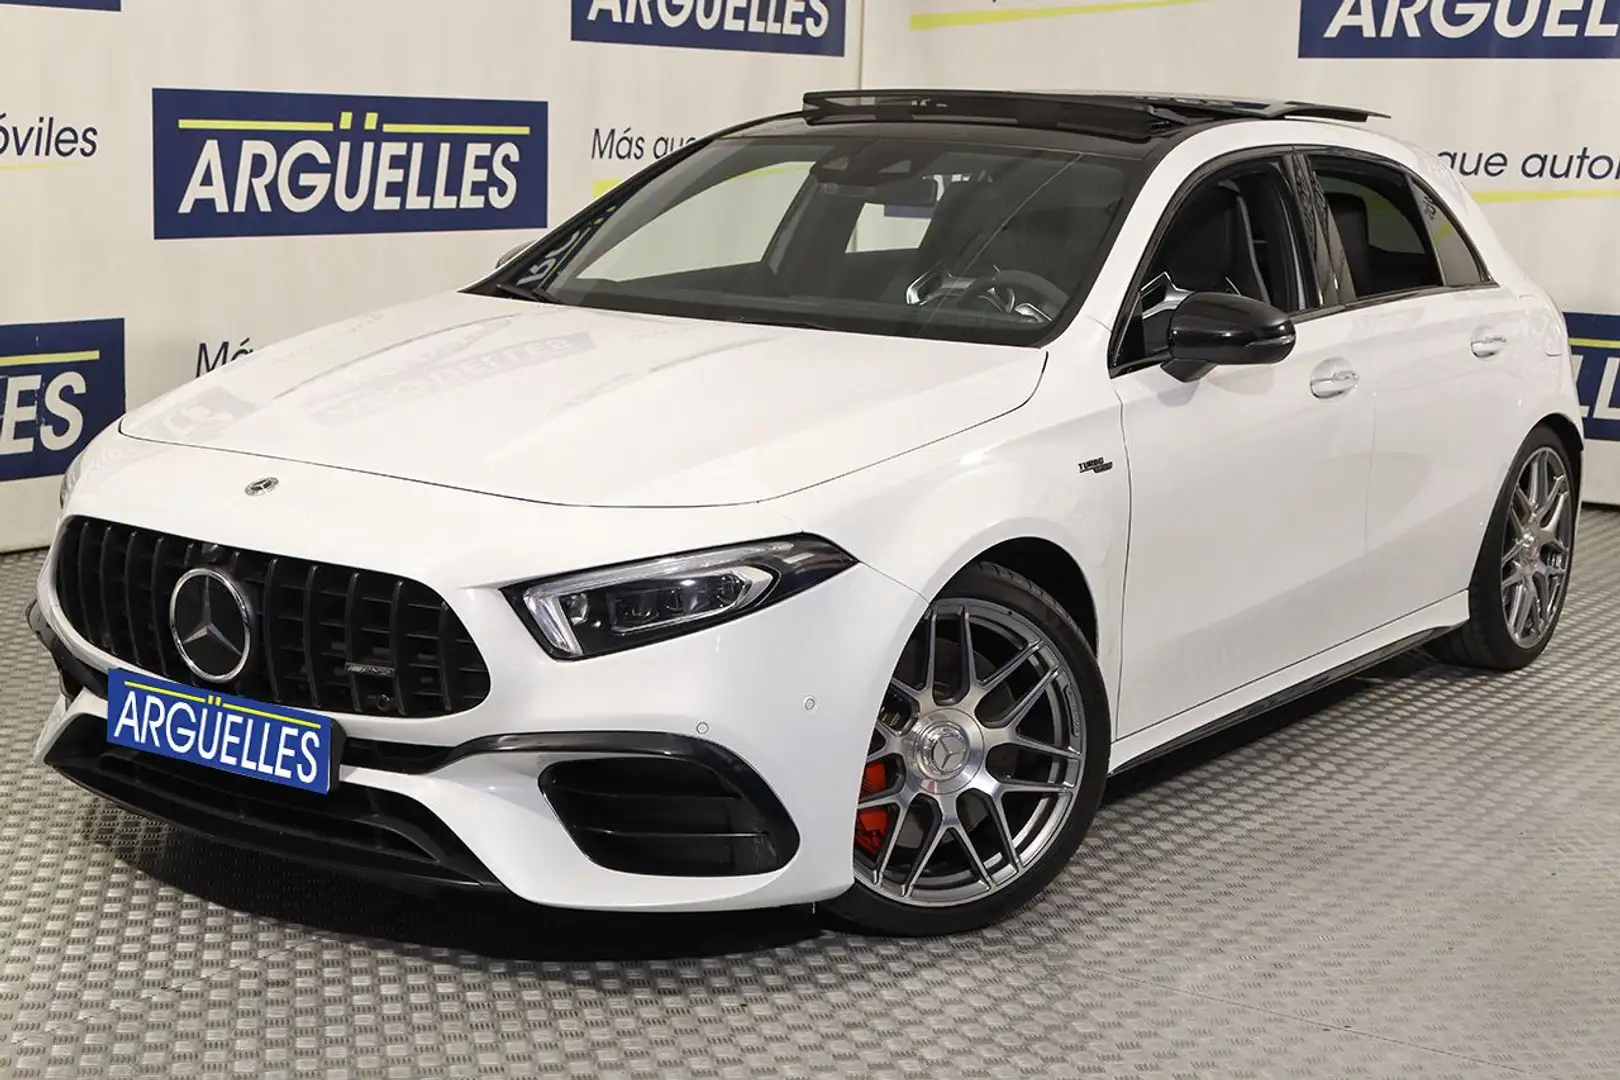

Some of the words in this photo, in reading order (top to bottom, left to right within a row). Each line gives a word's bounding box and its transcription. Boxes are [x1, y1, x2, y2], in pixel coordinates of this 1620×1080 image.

[178, 111, 520, 213] ARGÜELLES
[591, 127, 646, 160] Más
[1520, 147, 1620, 180] auto
[114, 690, 320, 784] ARGÜELLES
